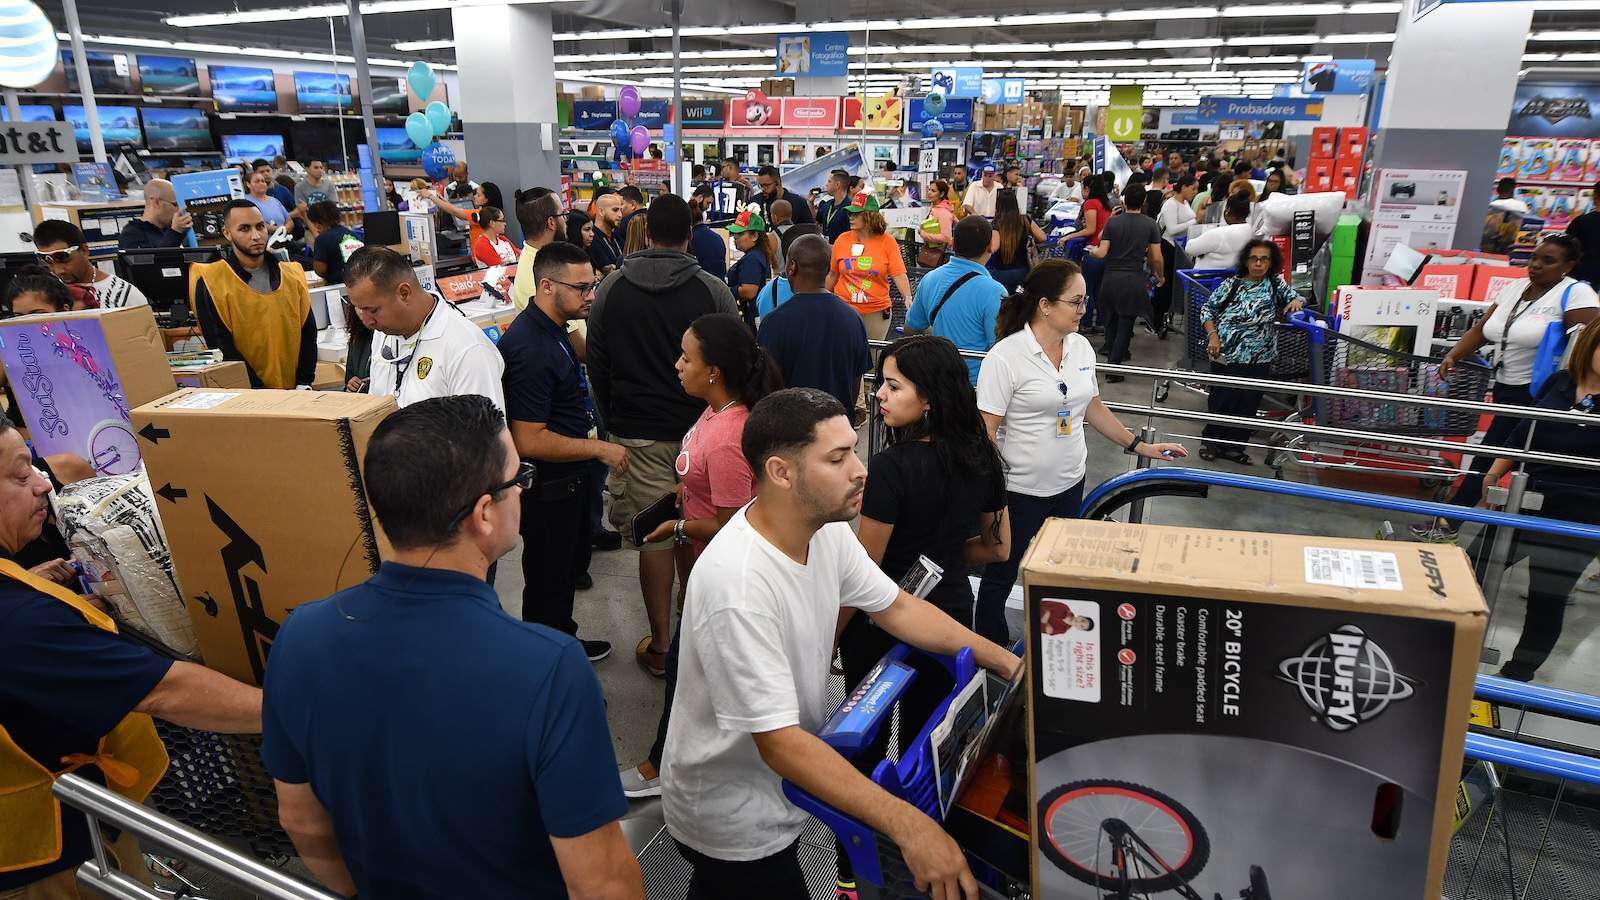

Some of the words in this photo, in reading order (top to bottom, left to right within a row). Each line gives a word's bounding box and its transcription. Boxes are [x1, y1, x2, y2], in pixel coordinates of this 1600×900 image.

[686, 107, 703, 118] Wii
[1228, 103, 1296, 115] Probadores
[0, 127, 64, 153] t&t
[449, 280, 474, 292] Claro
[1342, 293, 1353, 321] SANYO
[1418, 549, 1447, 598] HUFFY
[1154, 604, 1166, 641] Durable
[1175, 606, 1188, 641] Coaster
[1225, 608, 1243, 637] 20"
[1086, 642, 1095, 651] Is
[1196, 608, 1209, 666] Comfortable
[1073, 641, 1085, 663] right
[1086, 653, 1095, 671] this
[1154, 643, 1165, 665] steel
[1175, 641, 1187, 667] brake
[1075, 666, 1086, 689] size?
[1086, 673, 1096, 688] the
[1154, 666, 1166, 693] frame
[1194, 667, 1207, 703] padded
[1223, 641, 1242, 716] BICYCLE
[1327, 633, 1365, 724] HUFFY
[1195, 703, 1205, 723] seat
